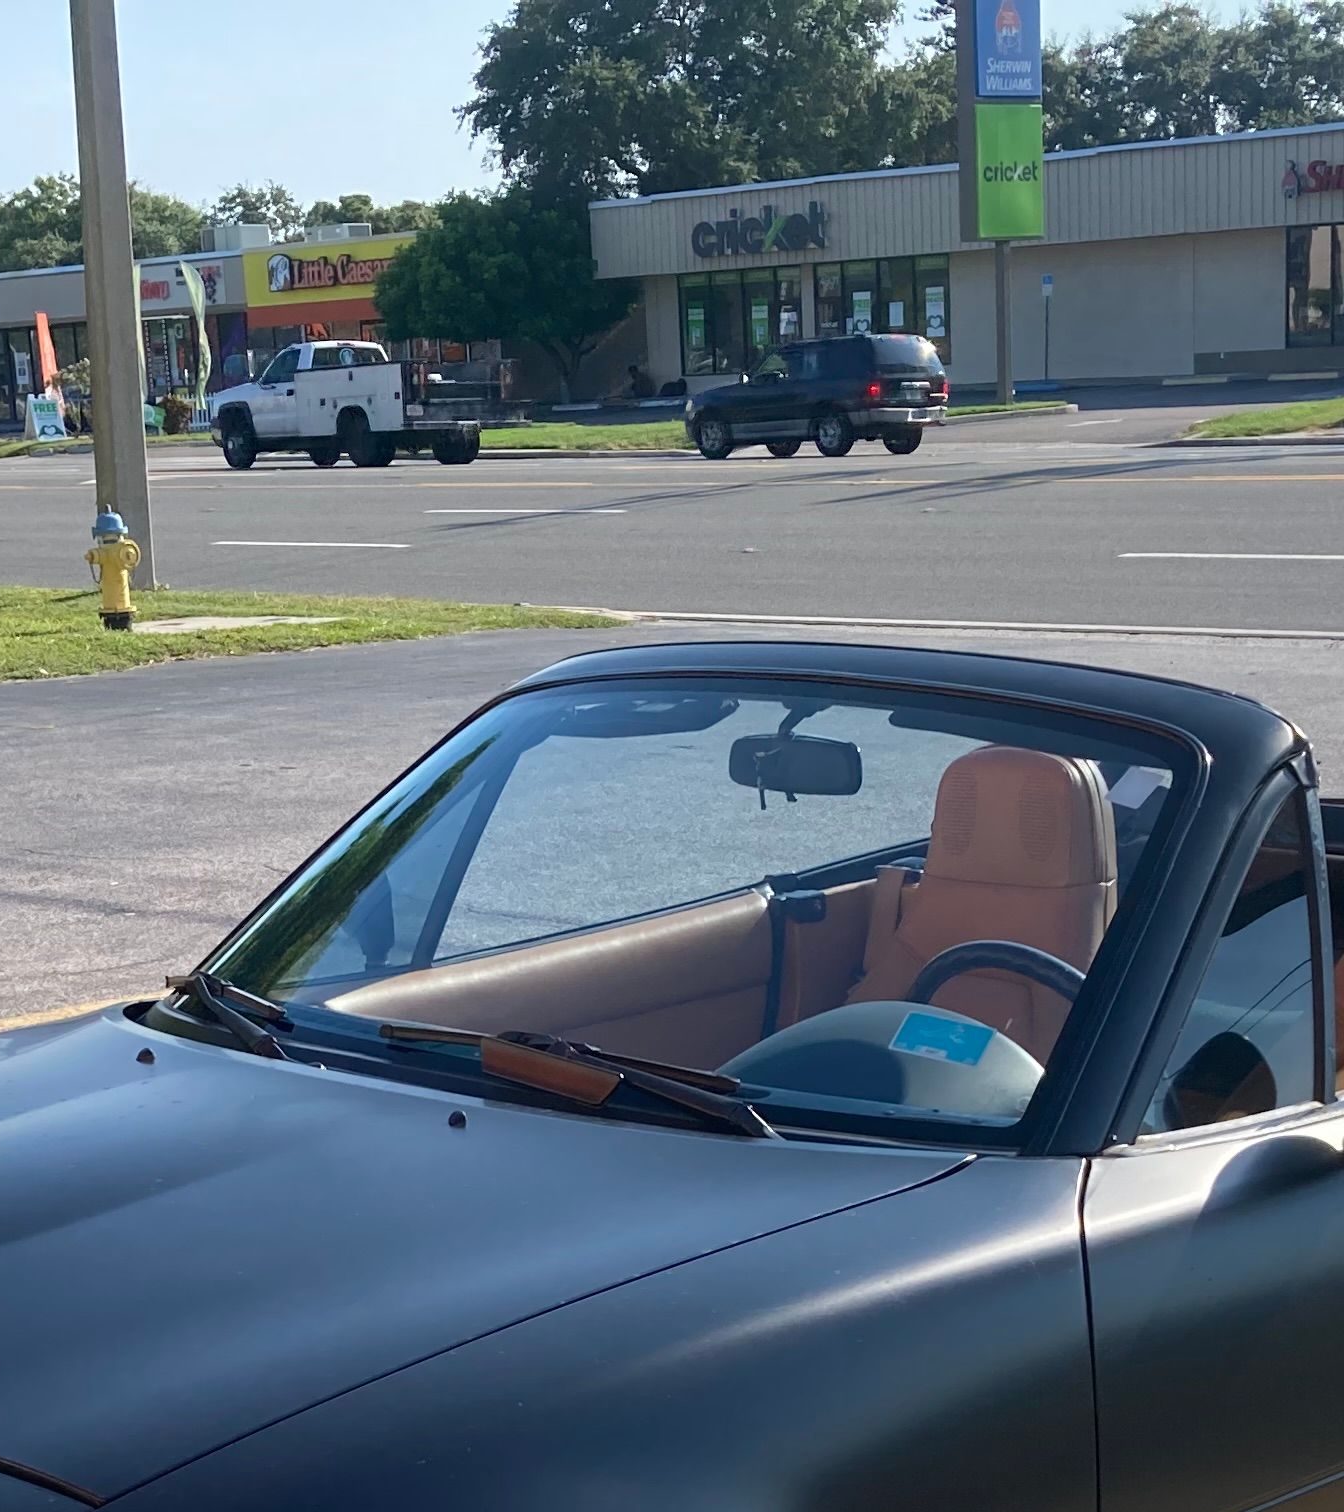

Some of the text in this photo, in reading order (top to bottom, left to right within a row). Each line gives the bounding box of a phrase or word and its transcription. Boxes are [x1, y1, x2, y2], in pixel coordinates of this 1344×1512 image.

[986, 57, 1032, 73] SHERWIN
[986, 75, 1032, 90] WILLIAMS
[983, 161, 1038, 182] cricket
[692, 201, 828, 257] cricket
[292, 256, 335, 288] Little
